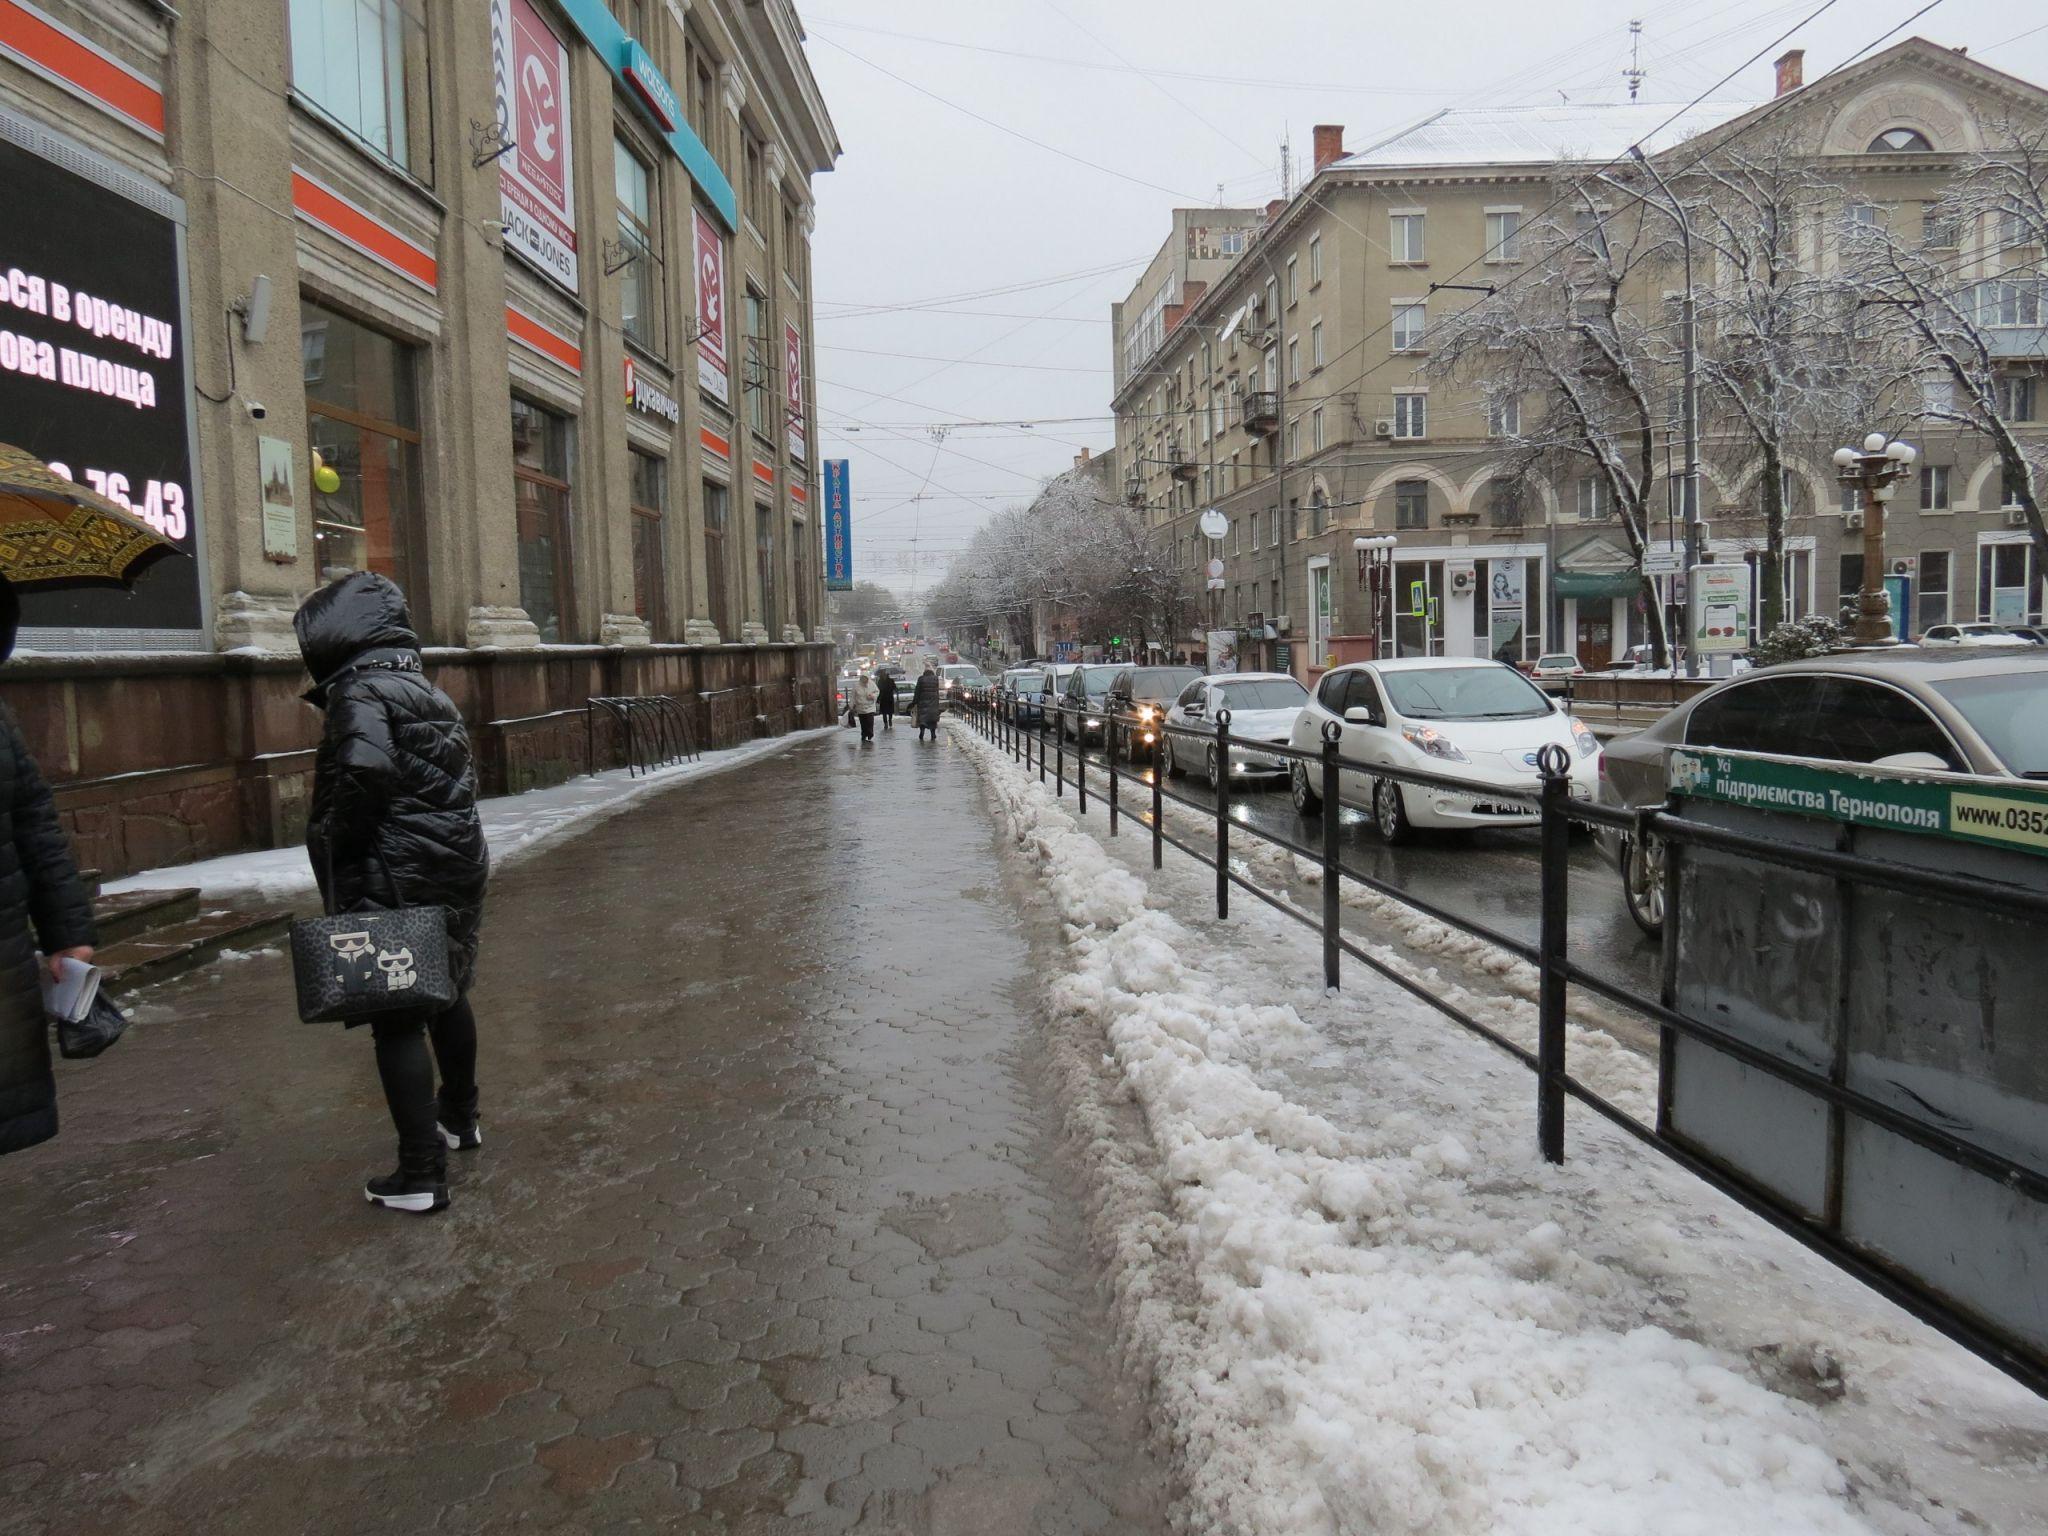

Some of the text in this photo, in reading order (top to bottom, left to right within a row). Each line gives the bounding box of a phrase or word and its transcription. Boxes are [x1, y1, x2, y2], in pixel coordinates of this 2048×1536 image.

[501, 206, 530, 243] JACK
[539, 238, 571, 276] JONES
[51, 282, 72, 322] в
[75, 292, 173, 359] оренду
[60, 348, 156, 409] площа
[634, 378, 679, 424] рукавичка
[1716, 758, 1731, 773] Усі
[1716, 775, 1940, 829] підприємства Тернополя
